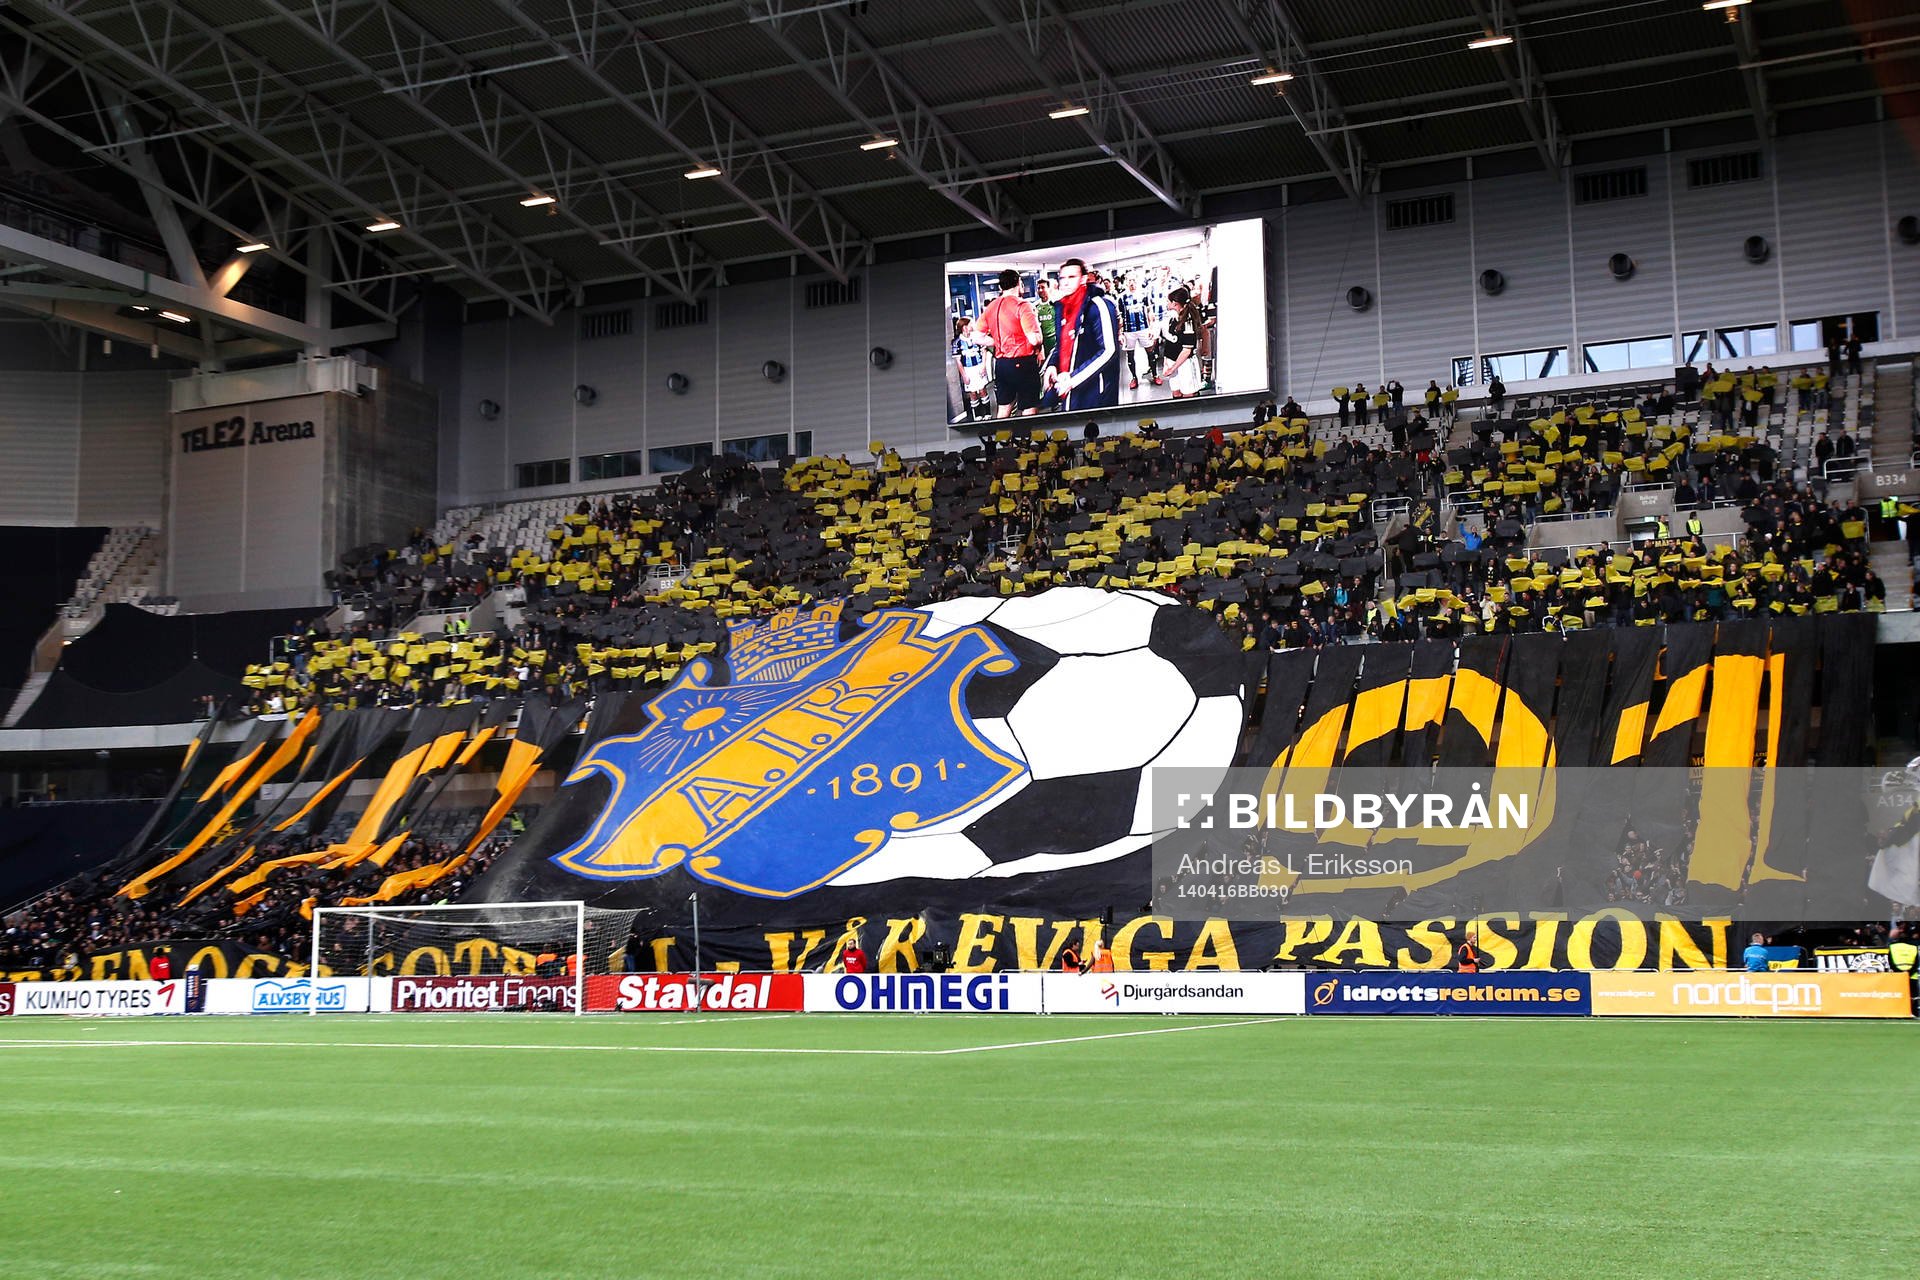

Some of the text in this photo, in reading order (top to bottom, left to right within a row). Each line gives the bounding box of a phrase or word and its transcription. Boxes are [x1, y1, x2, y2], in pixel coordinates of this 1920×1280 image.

[181, 416, 316, 453] TELE2 Arena
[1876, 473, 1907, 487] B334
[946, 913, 1242, 973] EVIGA
[1273, 906, 1733, 972] PASSION
[26, 989, 91, 1010] KUMHO
[96, 988, 152, 1009] TYRES
[397, 979, 500, 1009] Prioritet
[1123, 982, 1244, 1000] Djurgårdsandan
[1343, 985, 1581, 1002] idrottsreklam.se
[1672, 974, 1822, 1013] nordicpm
